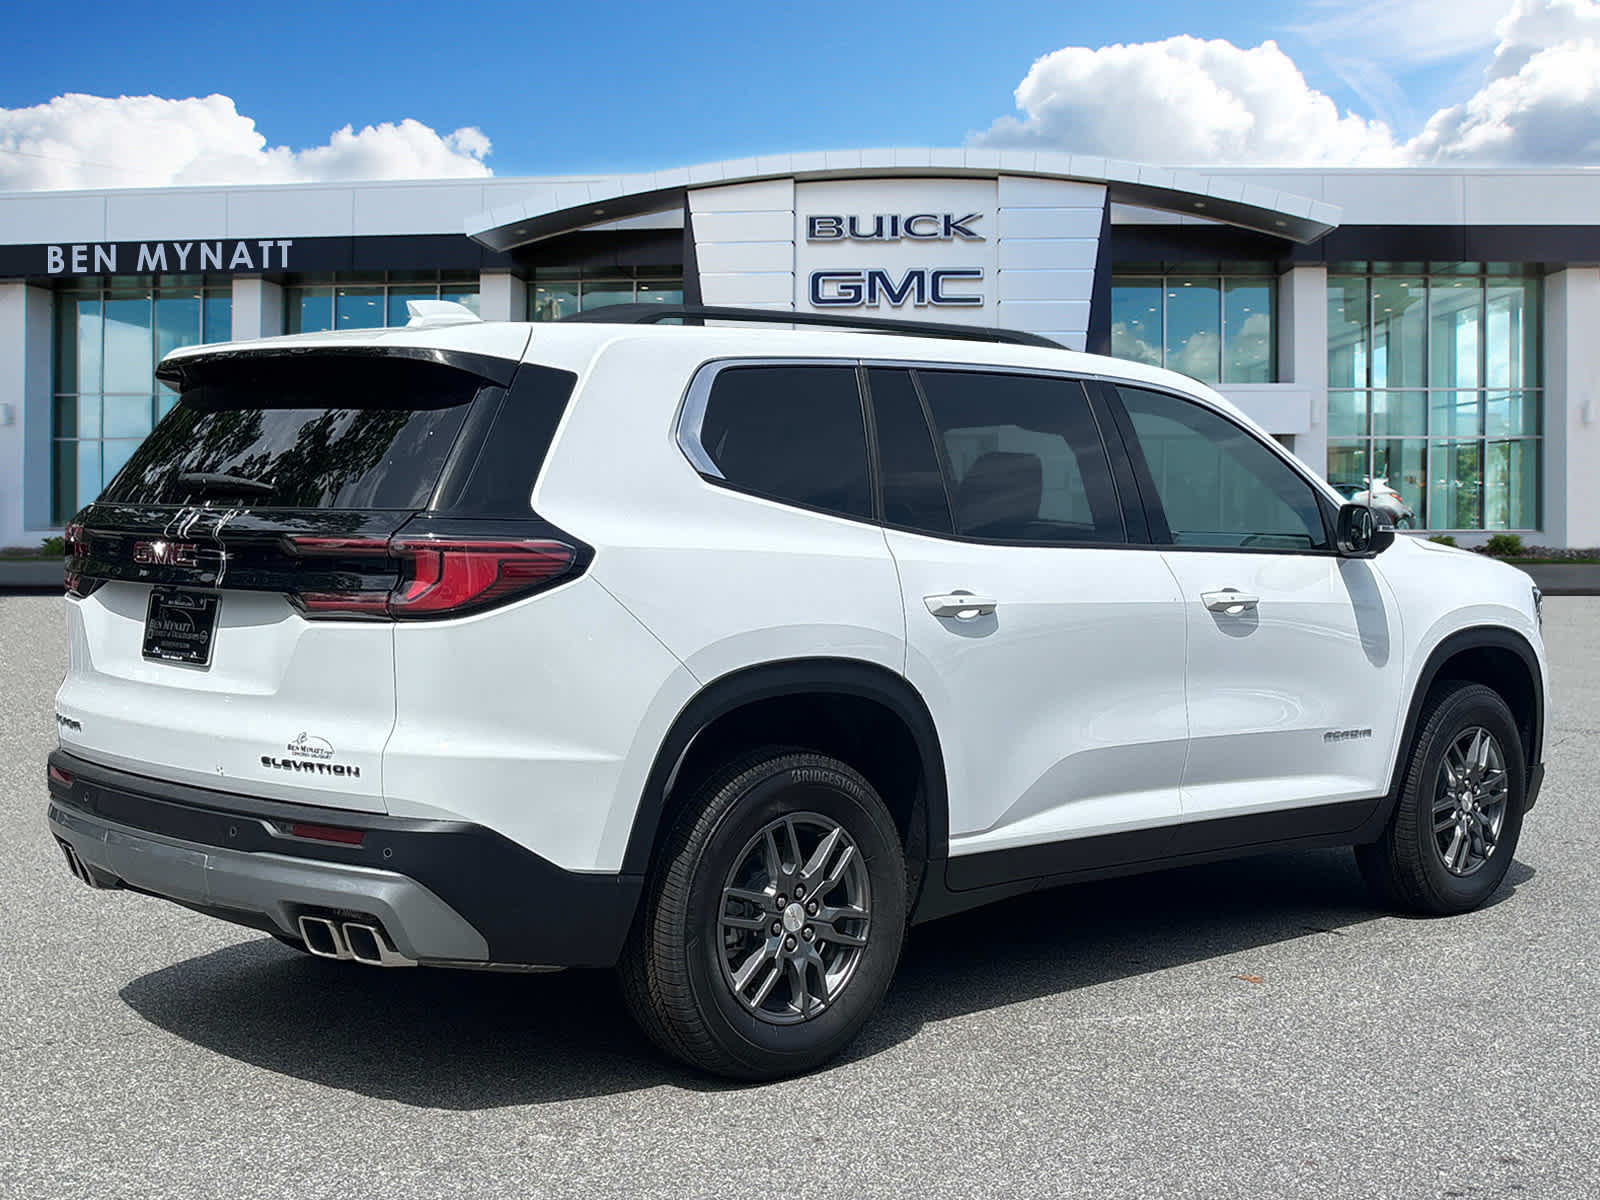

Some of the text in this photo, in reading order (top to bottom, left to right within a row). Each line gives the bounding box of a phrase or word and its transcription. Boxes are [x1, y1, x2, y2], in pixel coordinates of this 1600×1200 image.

[806, 213, 986, 242] BUICK
[47, 240, 293, 274] BEN MYNATT
[809, 267, 984, 308] GMC
[134, 541, 198, 567] GMC
[261, 756, 361, 777] ELEVATION
